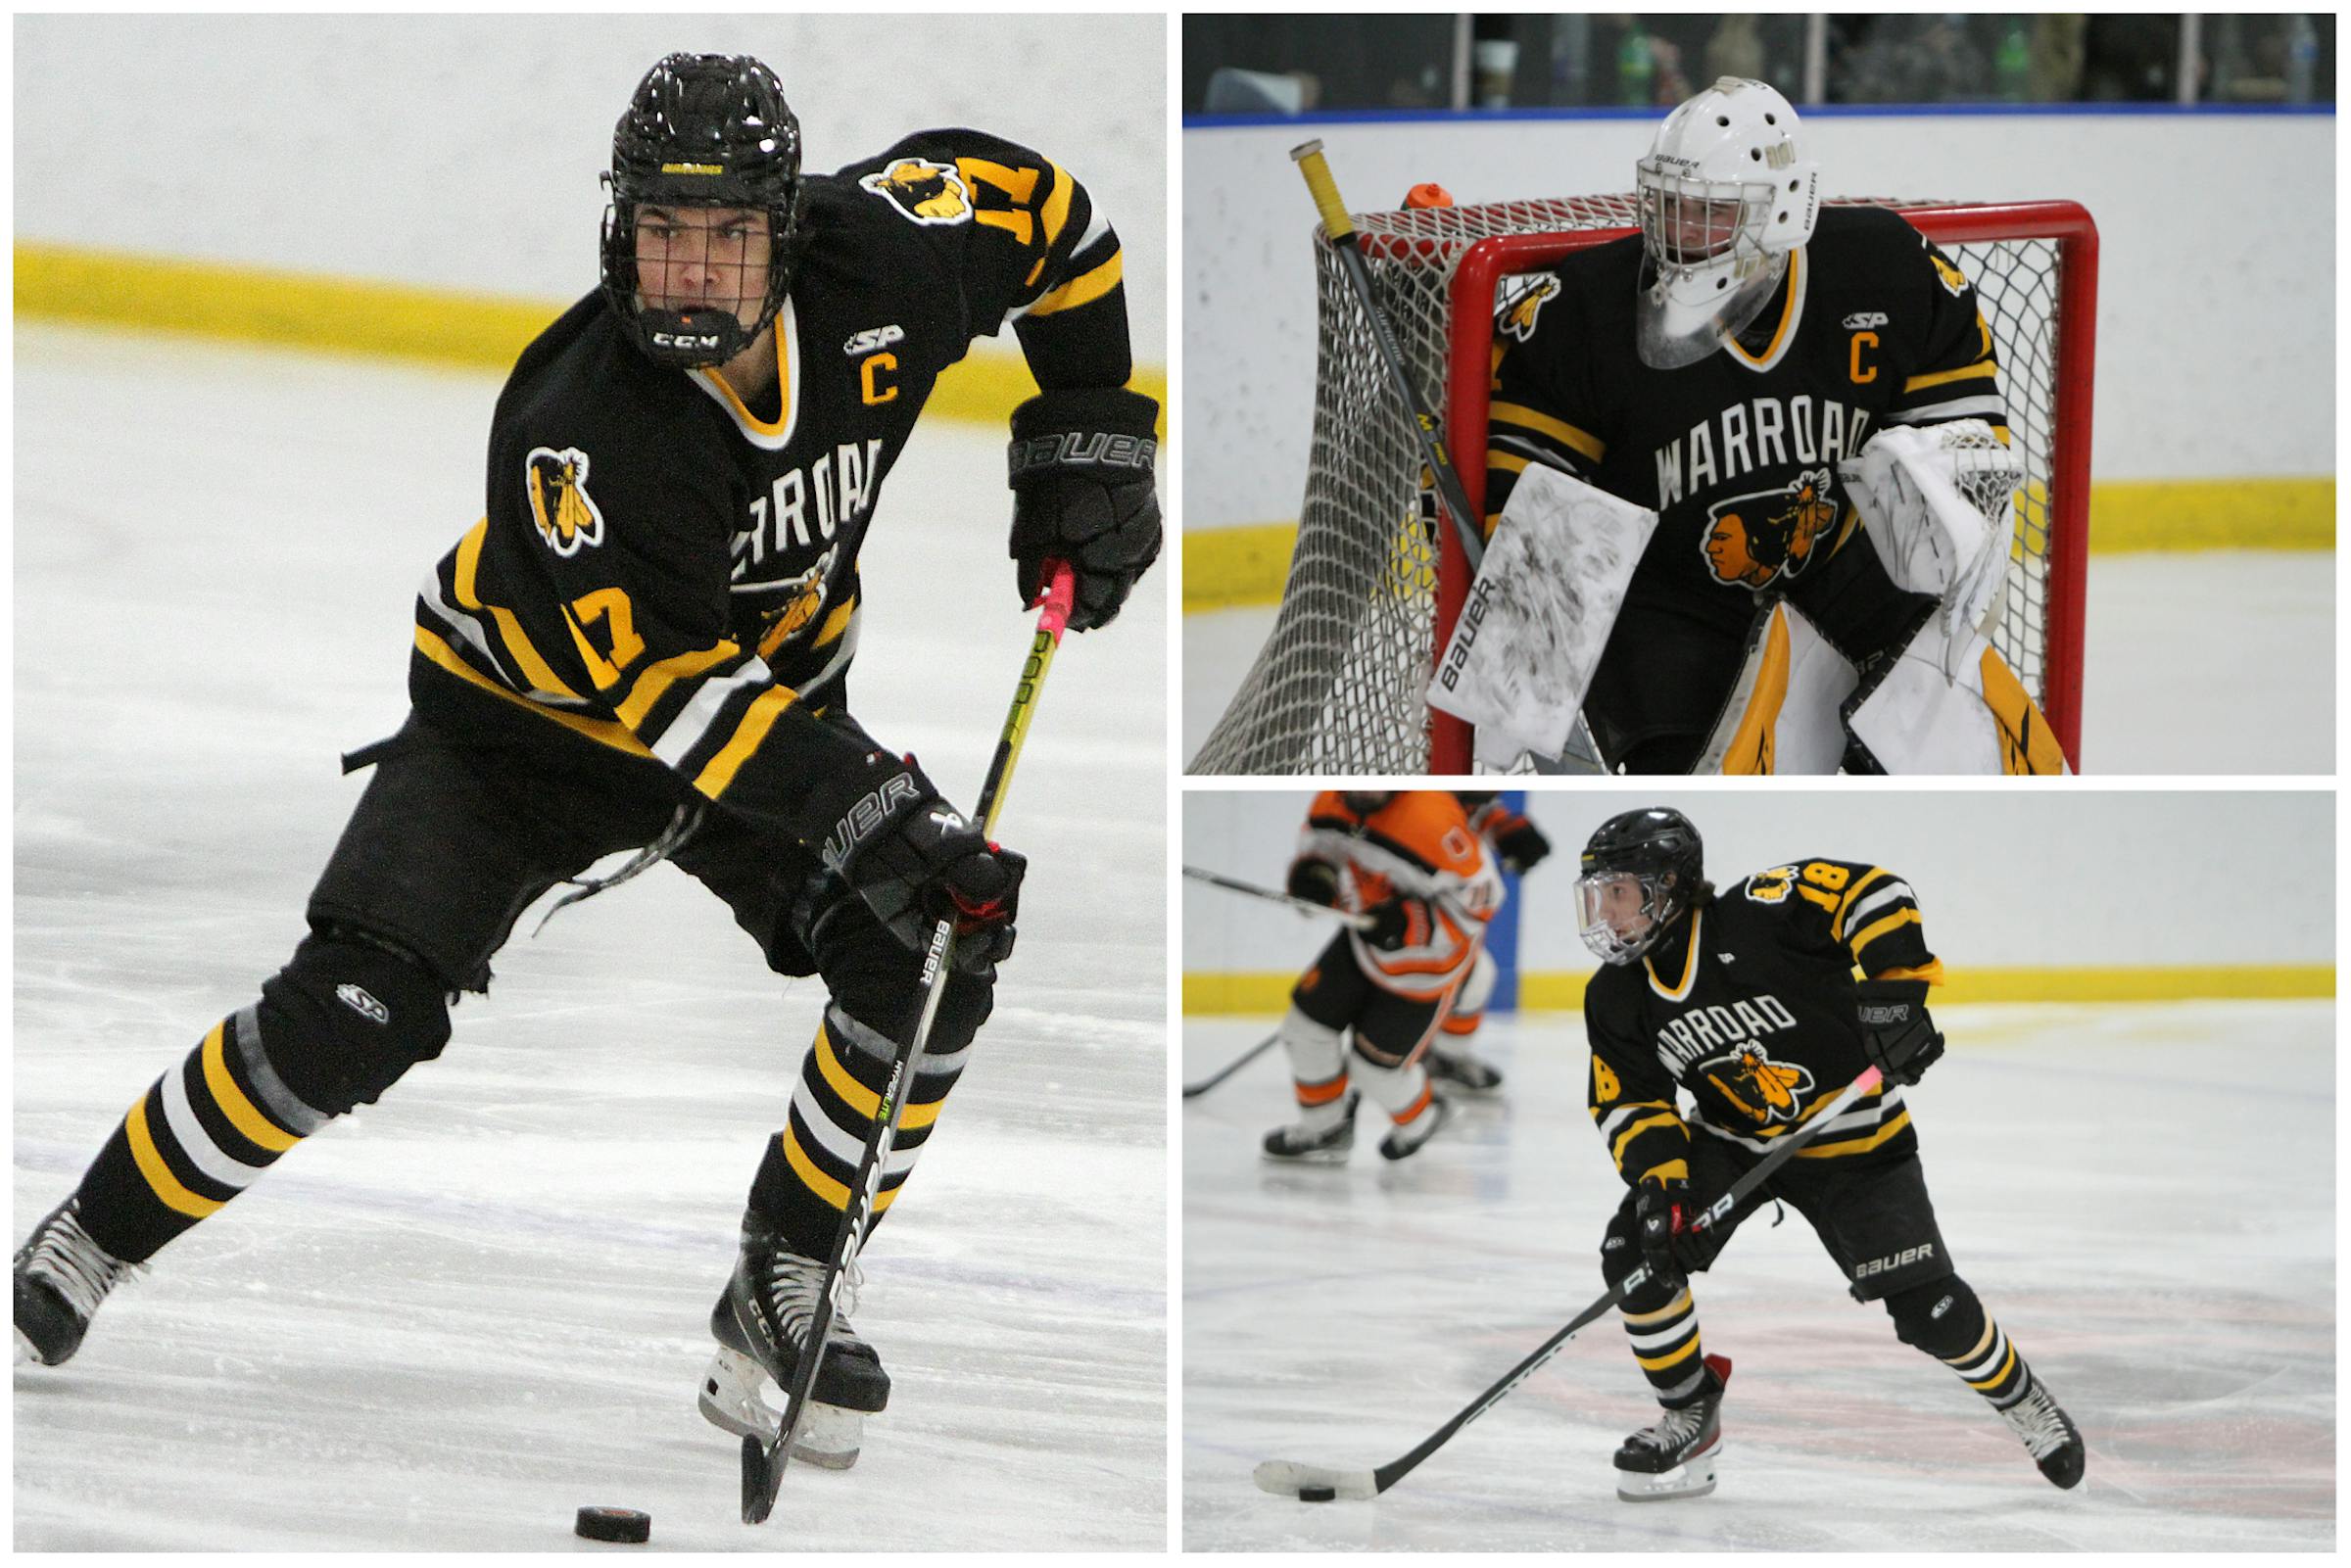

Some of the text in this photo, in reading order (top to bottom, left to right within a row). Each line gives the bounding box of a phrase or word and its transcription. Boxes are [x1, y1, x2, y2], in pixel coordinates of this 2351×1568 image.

[1655, 154, 1701, 168] BAUER
[1803, 171, 1818, 232] BAUER
[652, 332, 719, 350] CCM
[1849, 331, 1880, 384] C
[860, 352, 899, 405] C
[1009, 432, 1158, 472] AUER
[1655, 394, 1870, 512] WARROAD
[559, 587, 647, 690] 17
[1440, 576, 1497, 693] BAUER
[823, 772, 921, 872] UER
[1797, 861, 1850, 914] 18
[919, 919, 951, 988] BAUER
[1656, 994, 1798, 1080] WARROAD
[1856, 1003, 1910, 1023] UER
[1855, 1242, 1935, 1279] BAUER
